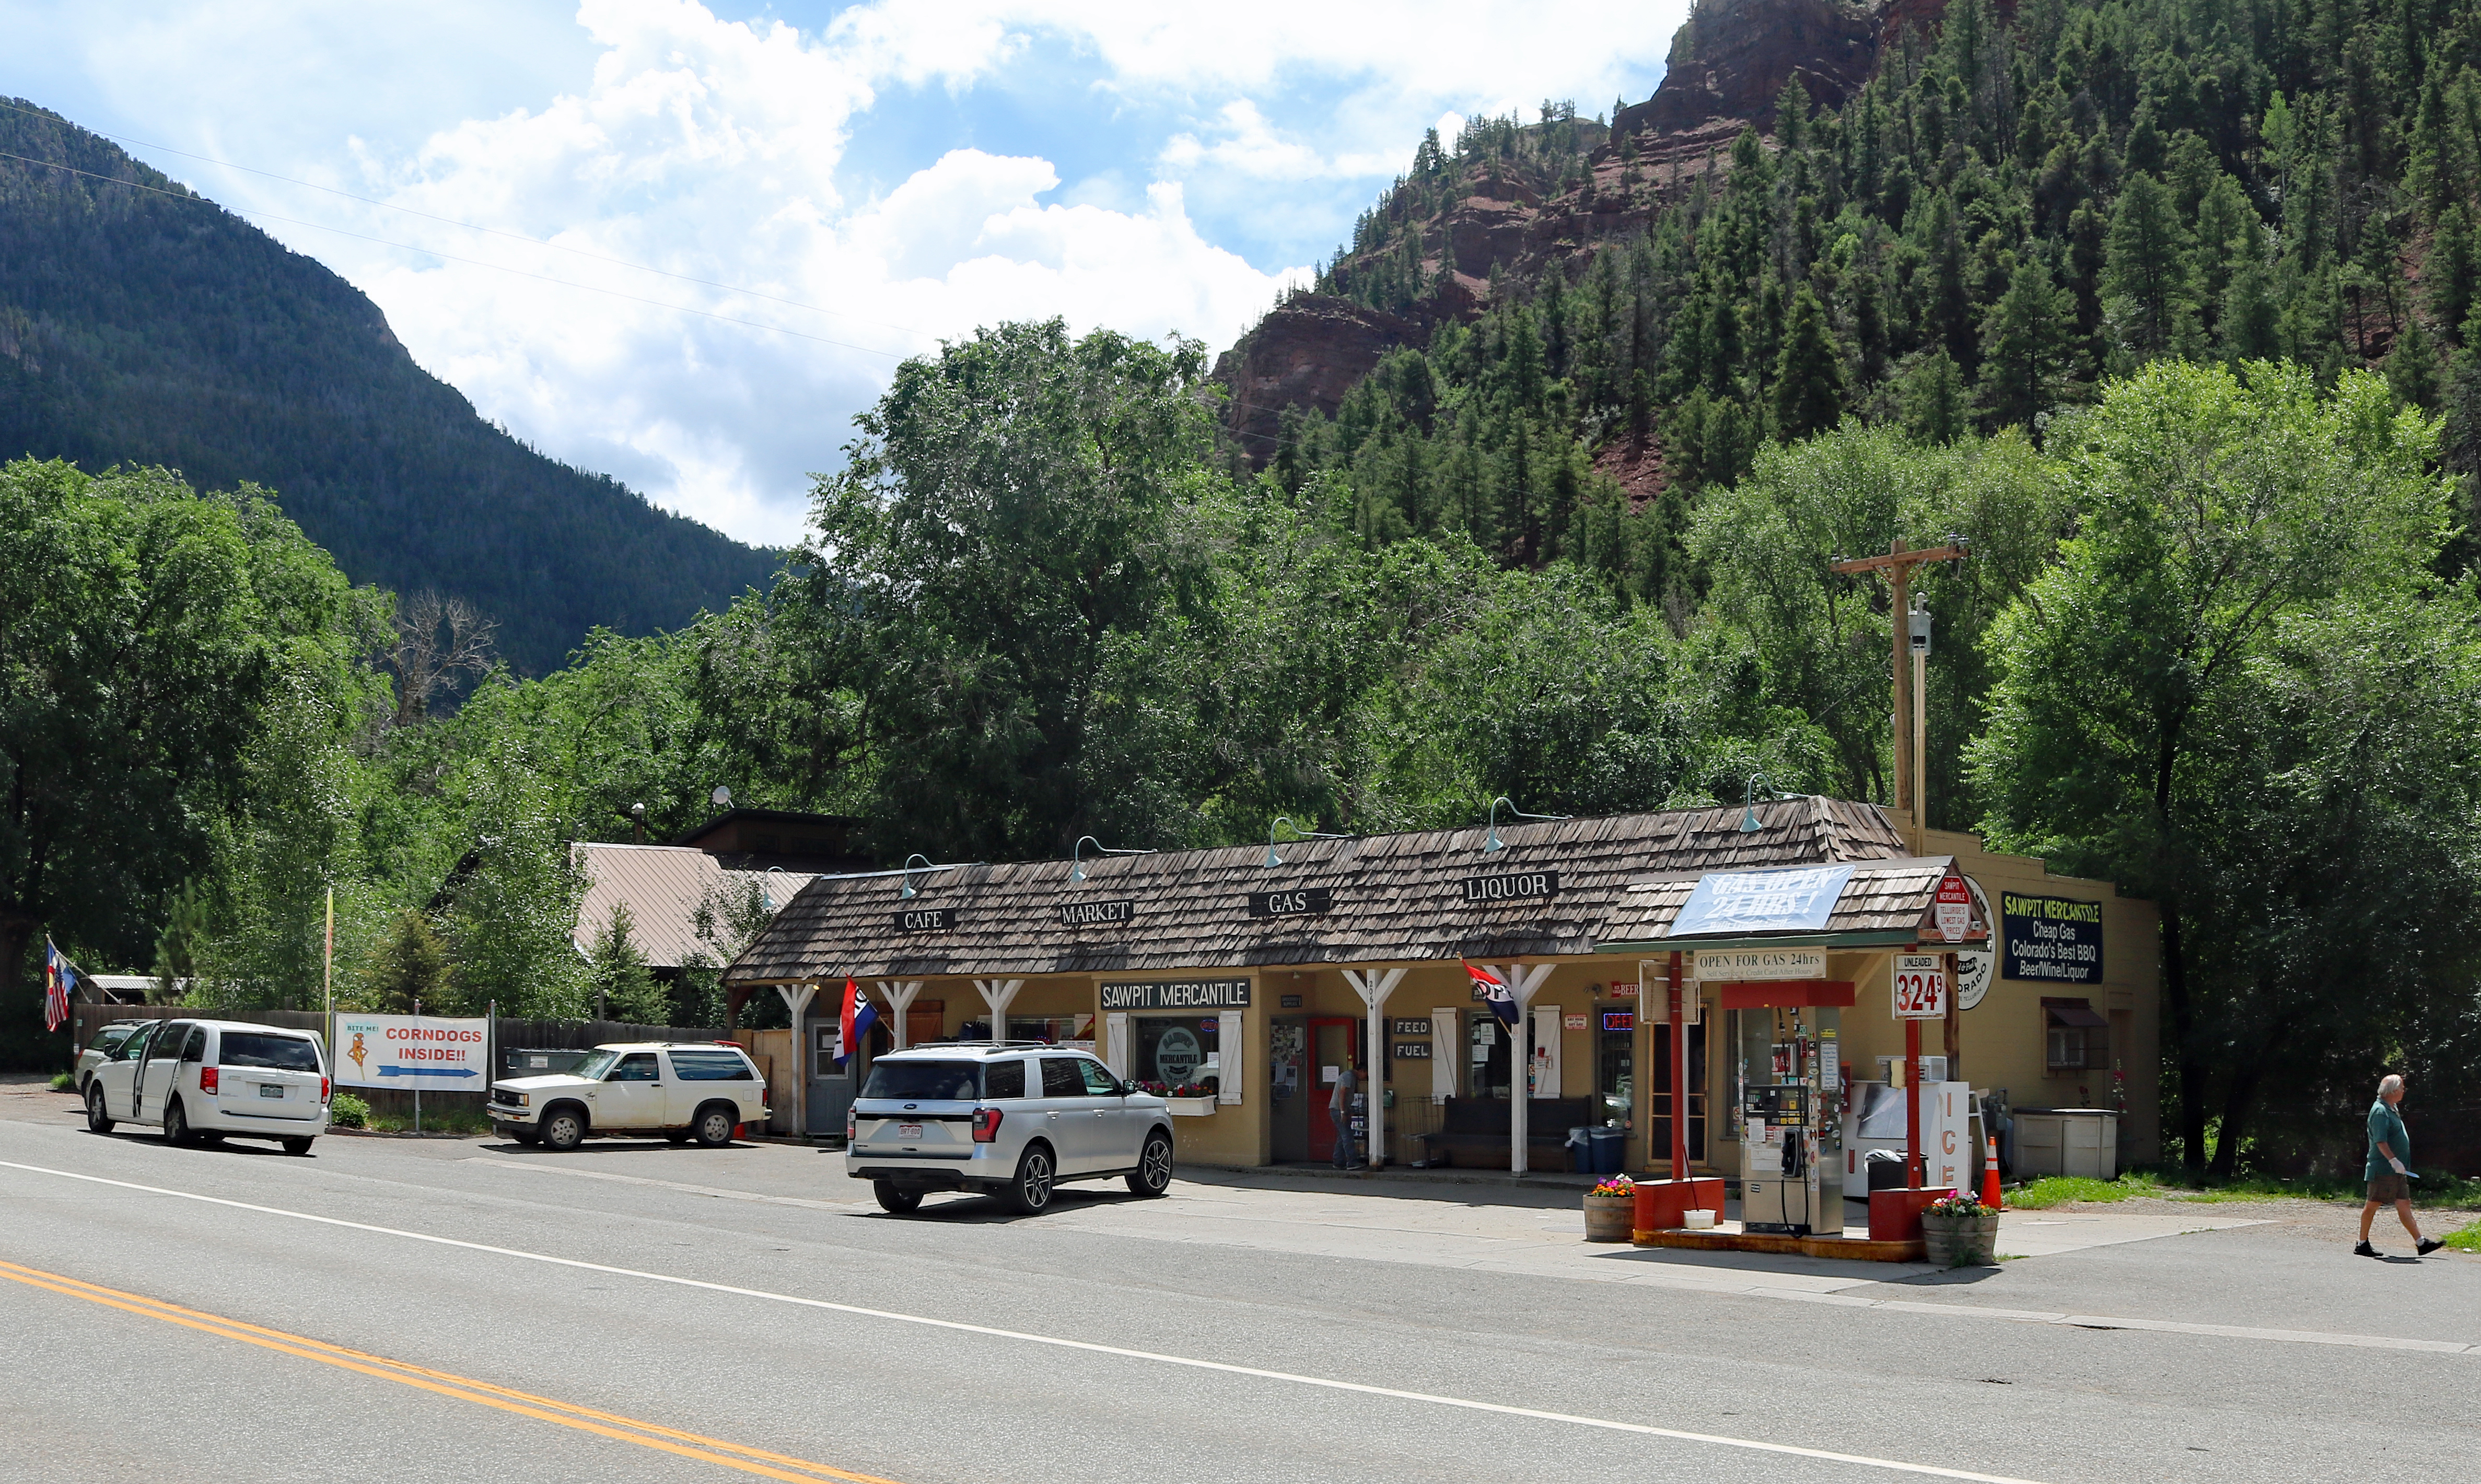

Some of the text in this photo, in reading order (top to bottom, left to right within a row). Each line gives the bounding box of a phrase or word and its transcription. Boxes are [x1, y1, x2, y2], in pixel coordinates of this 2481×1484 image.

[1466, 874, 1549, 901] LIQUOR
[1711, 869, 1834, 895] GAS OPEN
[1944, 882, 1959, 890] SAWPIT
[1268, 892, 1307, 913] GAS
[1940, 892, 1965, 901] MERCANTILE
[1062, 902, 1129, 924] MARKET
[1704, 895, 1744, 918] 24
[2005, 896, 2042, 917] SAWPIT
[2044, 900, 2099, 922] MERCANTILE
[904, 911, 942, 929] CAFE
[2033, 921, 2075, 942] Cheap Gas
[2012, 939, 2055, 959] Colorado's
[2058, 942, 2076, 960] Best
[2078, 944, 2095, 962] BBQ
[1700, 953, 1819, 968] OPEN FOR GAS 24hrs
[1904, 957, 1931, 966] UNLEADED
[1959, 963, 1986, 992] ORADO
[2019, 960, 2089, 981] Beer/Wine/Liquor
[1103, 985, 1152, 1007] SAWPIT
[1621, 984, 1639, 995] BEER
[386, 1028, 482, 1043] CORNDOGS
[1397, 1022, 1427, 1033] FEED
[399, 1048, 465, 1061] INSIDE!!
[1160, 1054, 1197, 1064] MERCANTILE
[1397, 1046, 1428, 1056] FUEL
